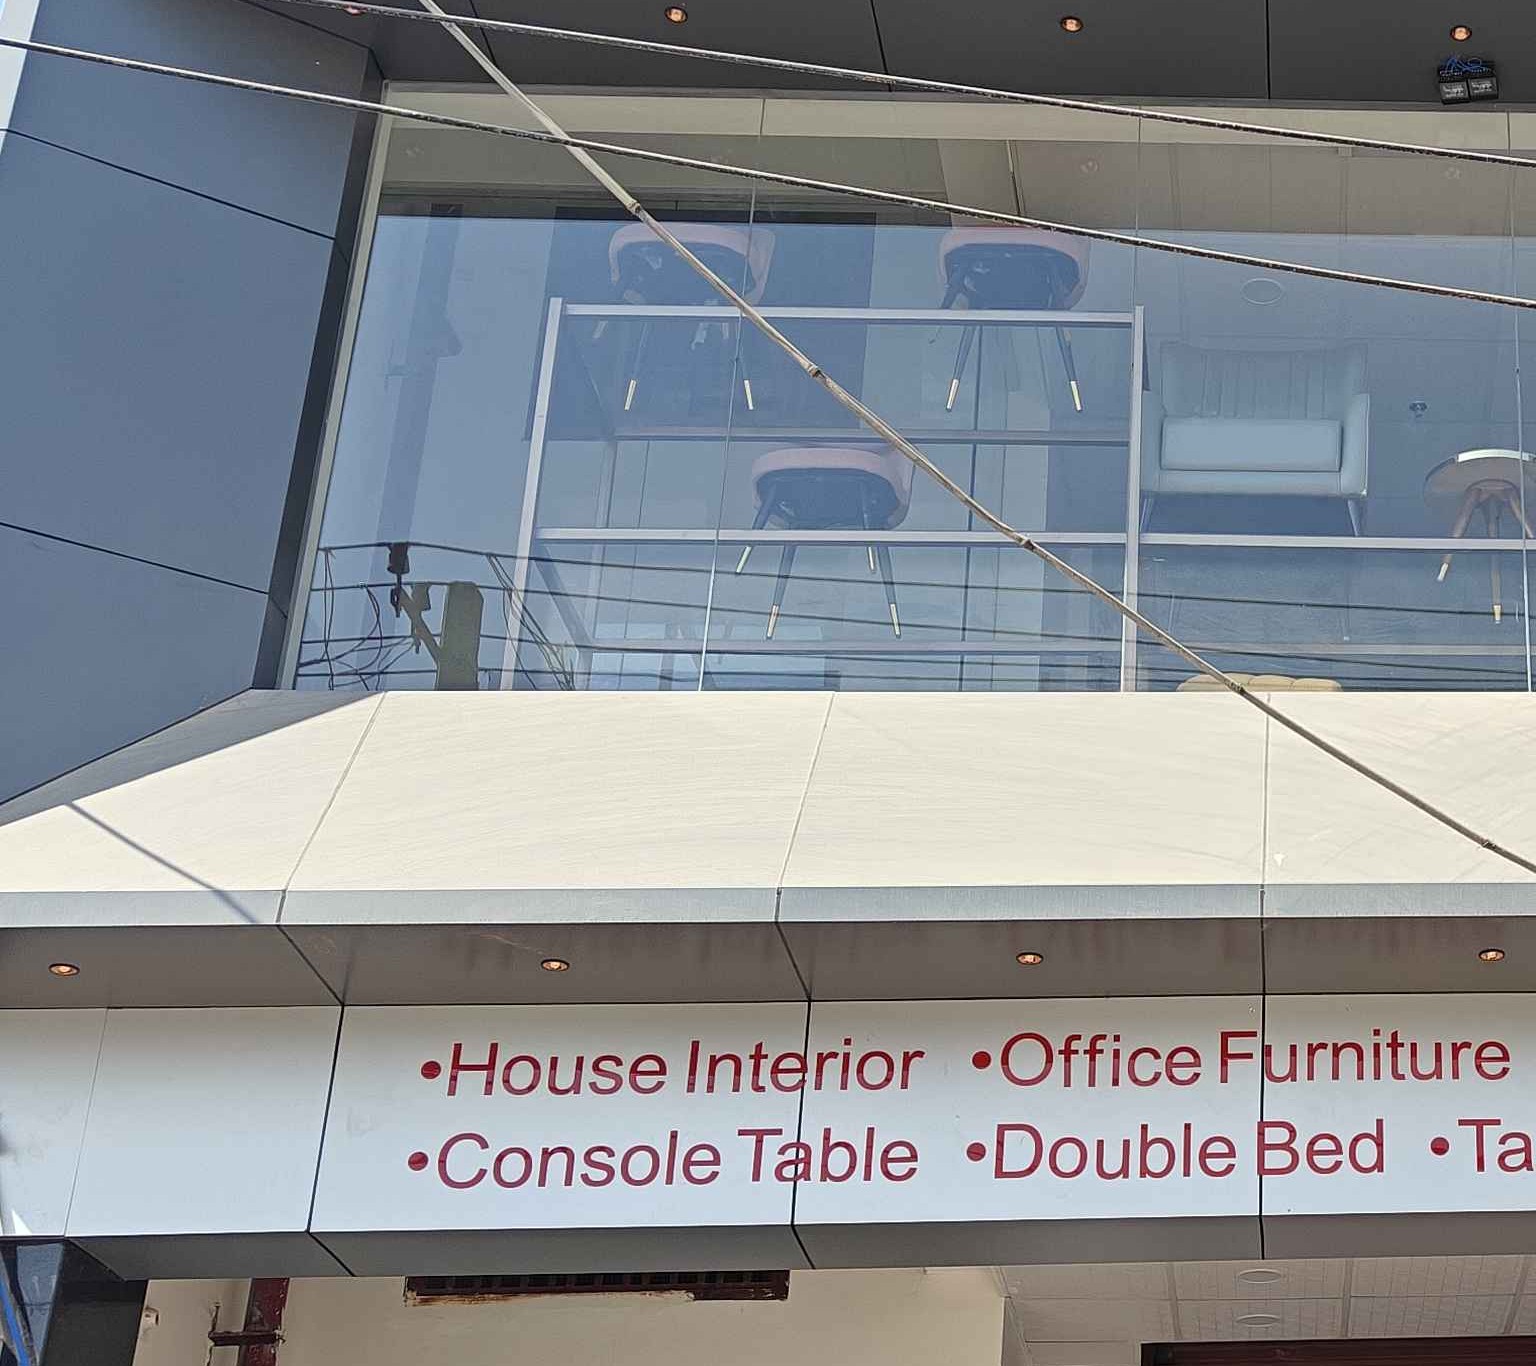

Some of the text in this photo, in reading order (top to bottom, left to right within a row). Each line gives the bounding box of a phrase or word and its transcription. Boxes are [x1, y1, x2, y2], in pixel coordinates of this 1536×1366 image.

[446, 1036, 926, 1097] House Interior
[1001, 1029, 1511, 1088] Office Furniture
[437, 1126, 918, 1189] Console Table
[995, 1119, 1385, 1179] Double Bed
